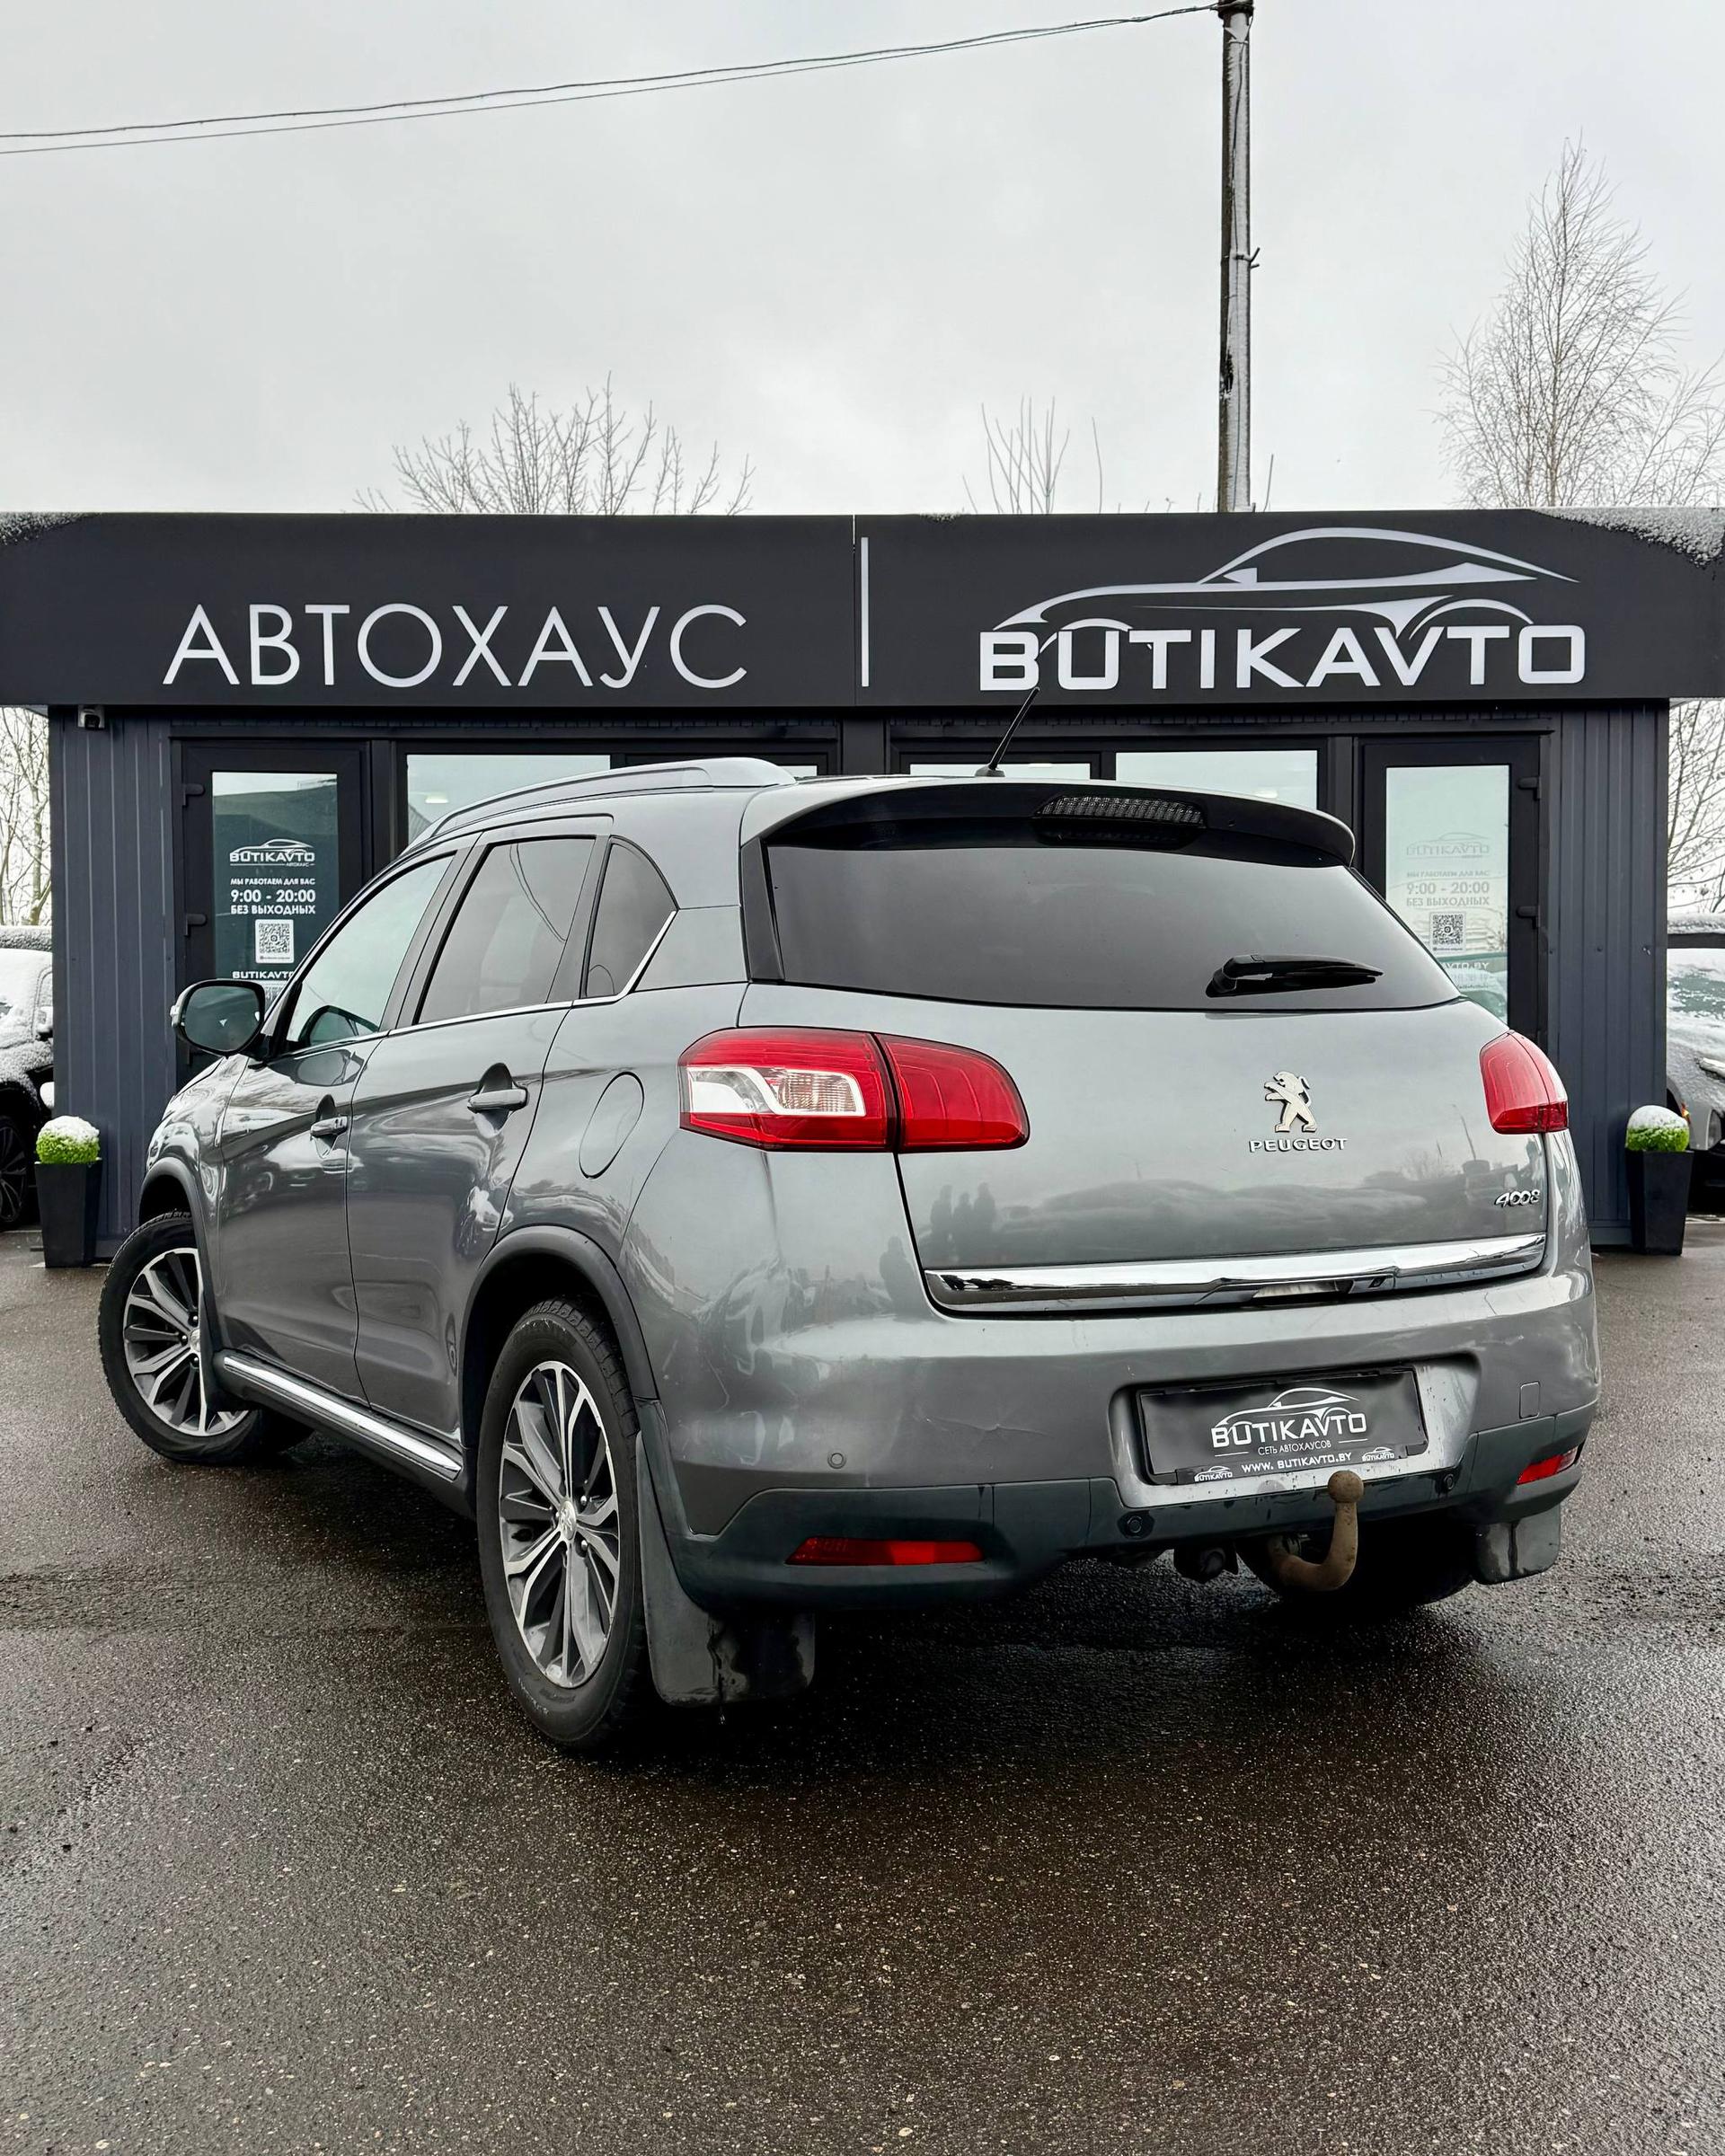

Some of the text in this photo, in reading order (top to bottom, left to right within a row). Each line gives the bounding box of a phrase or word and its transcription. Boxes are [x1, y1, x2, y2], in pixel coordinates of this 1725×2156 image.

[163, 604, 748, 689] АВТОХАУС
[978, 624, 1587, 691] BUTIKAVTO
[229, 852, 315, 862] BUTIKAVTO
[230, 889, 261, 903] 9:00
[276, 888, 316, 903] 20:00
[1406, 881, 1437, 895] 9:00
[1451, 881, 1491, 894] 20:00
[1406, 897, 1491, 907] БЕЗ ВЫХОДНЫХ
[230, 905, 316, 915] БЕЗ ВЫХОДНЫХ
[1249, 1138, 1349, 1153] PEUGEOT
[1494, 1189, 1541, 1209] 4008
[1210, 1412, 1367, 1448] BUTIKAVTO
[1258, 1440, 1332, 1456] СЕТЬ АВТОХАУСОВ
[1277, 1452, 1353, 1470] BUTIKAVTO.BY
